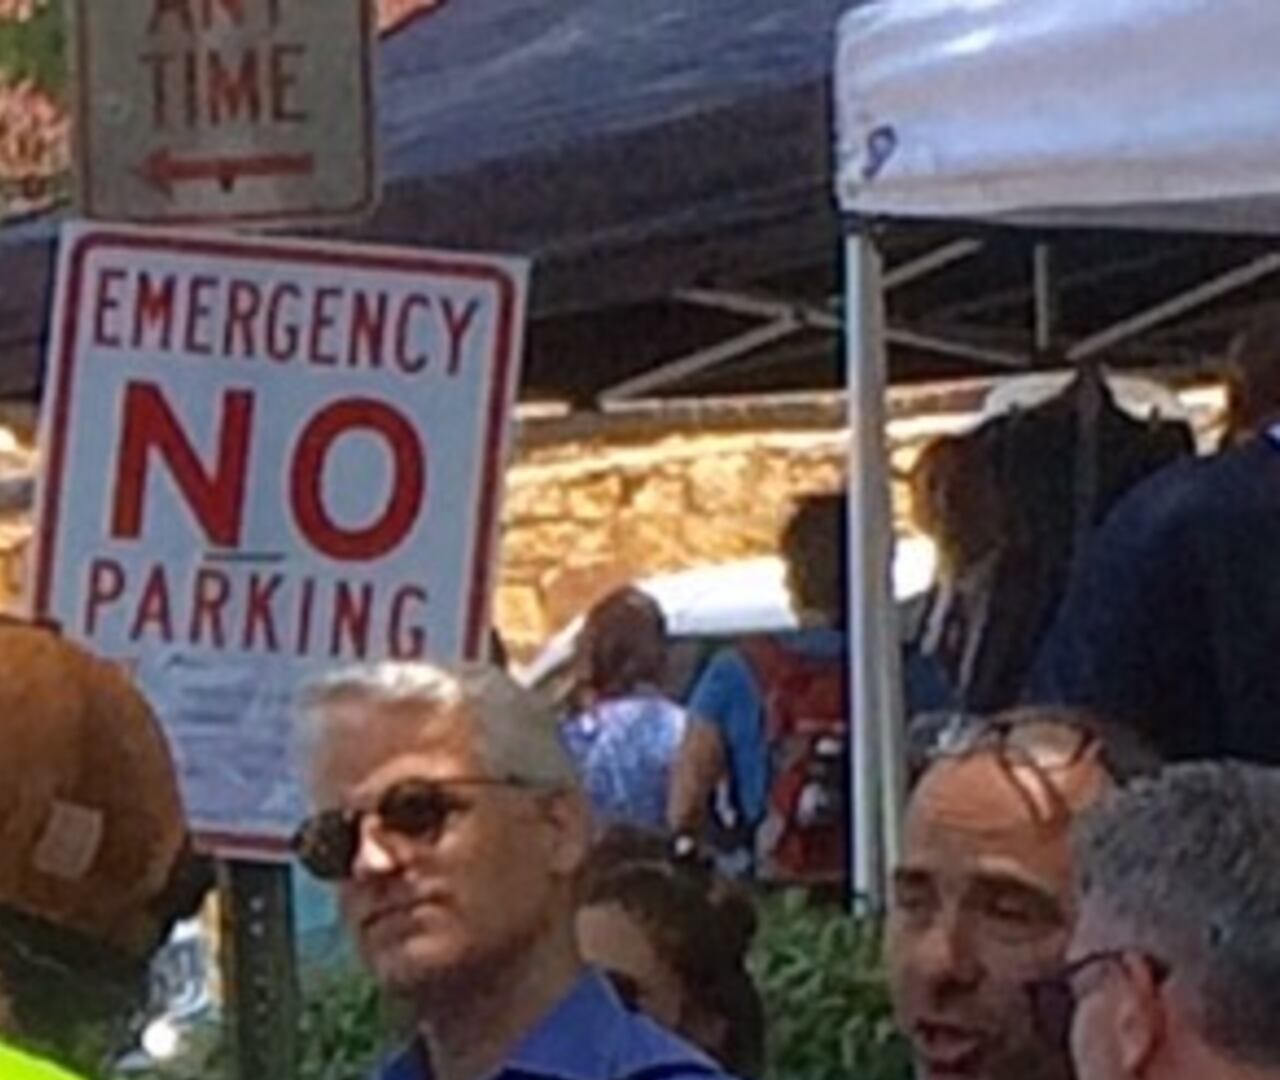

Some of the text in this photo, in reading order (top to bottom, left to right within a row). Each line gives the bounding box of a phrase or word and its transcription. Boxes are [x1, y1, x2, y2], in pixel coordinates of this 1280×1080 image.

[138, 43, 309, 129] TIME
[92, 268, 481, 377] EMERGENCY
[109, 379, 427, 563] NO
[85, 557, 428, 661] PARKING
